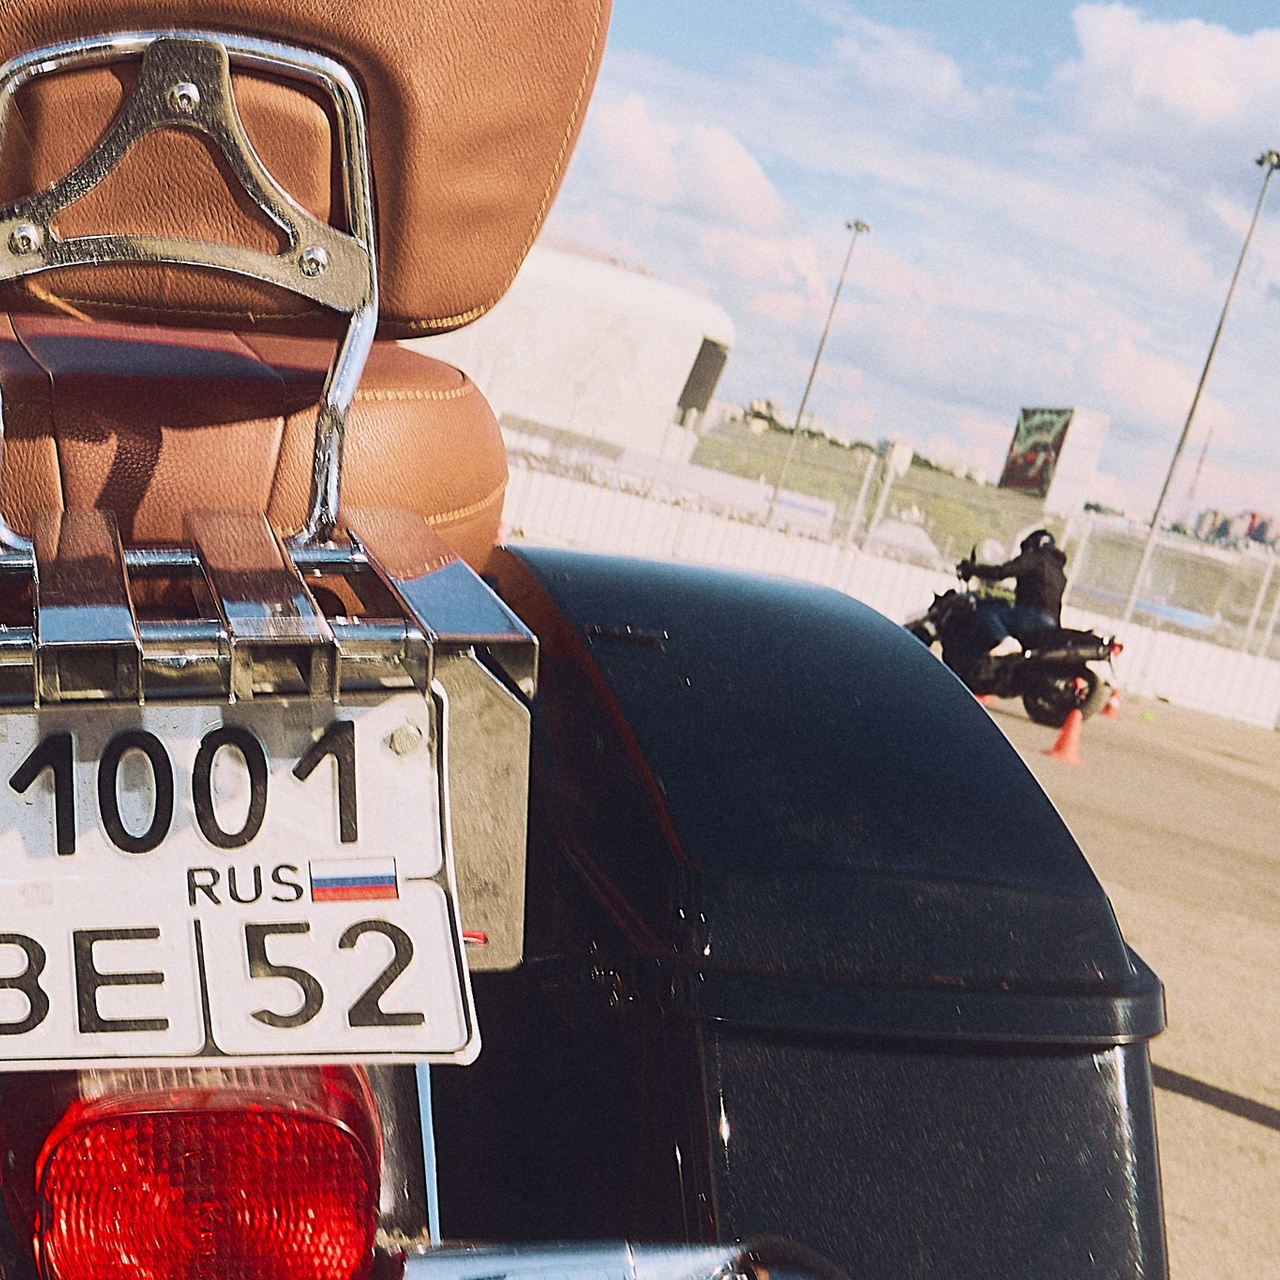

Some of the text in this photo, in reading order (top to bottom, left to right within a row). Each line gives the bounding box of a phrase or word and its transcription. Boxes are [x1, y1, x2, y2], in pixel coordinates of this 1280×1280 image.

[9, 720, 358, 857] 1001
[187, 863, 304, 907] RUS
[244, 919, 426, 1029] 52
